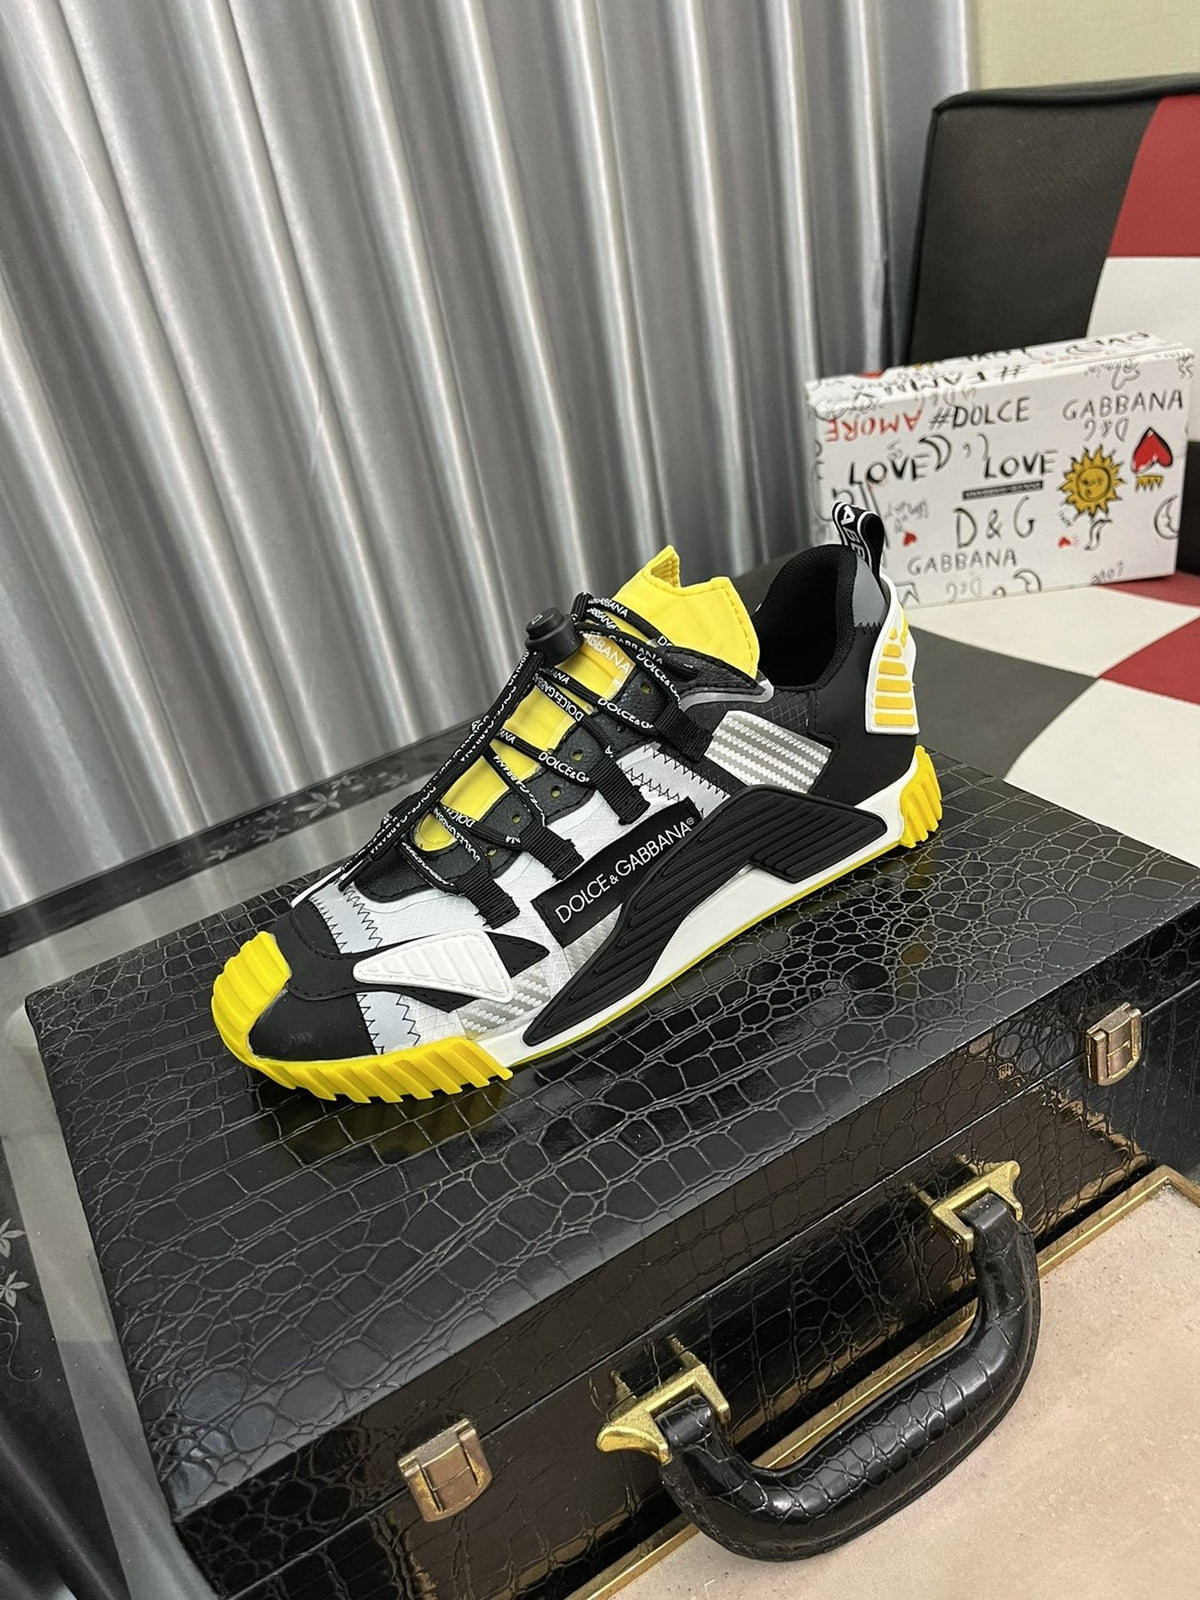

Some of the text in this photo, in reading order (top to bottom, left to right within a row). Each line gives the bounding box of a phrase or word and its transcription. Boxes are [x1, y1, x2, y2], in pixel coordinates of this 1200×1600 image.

[929, 397, 1031, 429] #DOLCE
[1062, 389, 1183, 420] GABBANA
[848, 455, 930, 485] LOVE
[983, 449, 1058, 479] LOVE
[907, 549, 1017, 576] GABBANA
